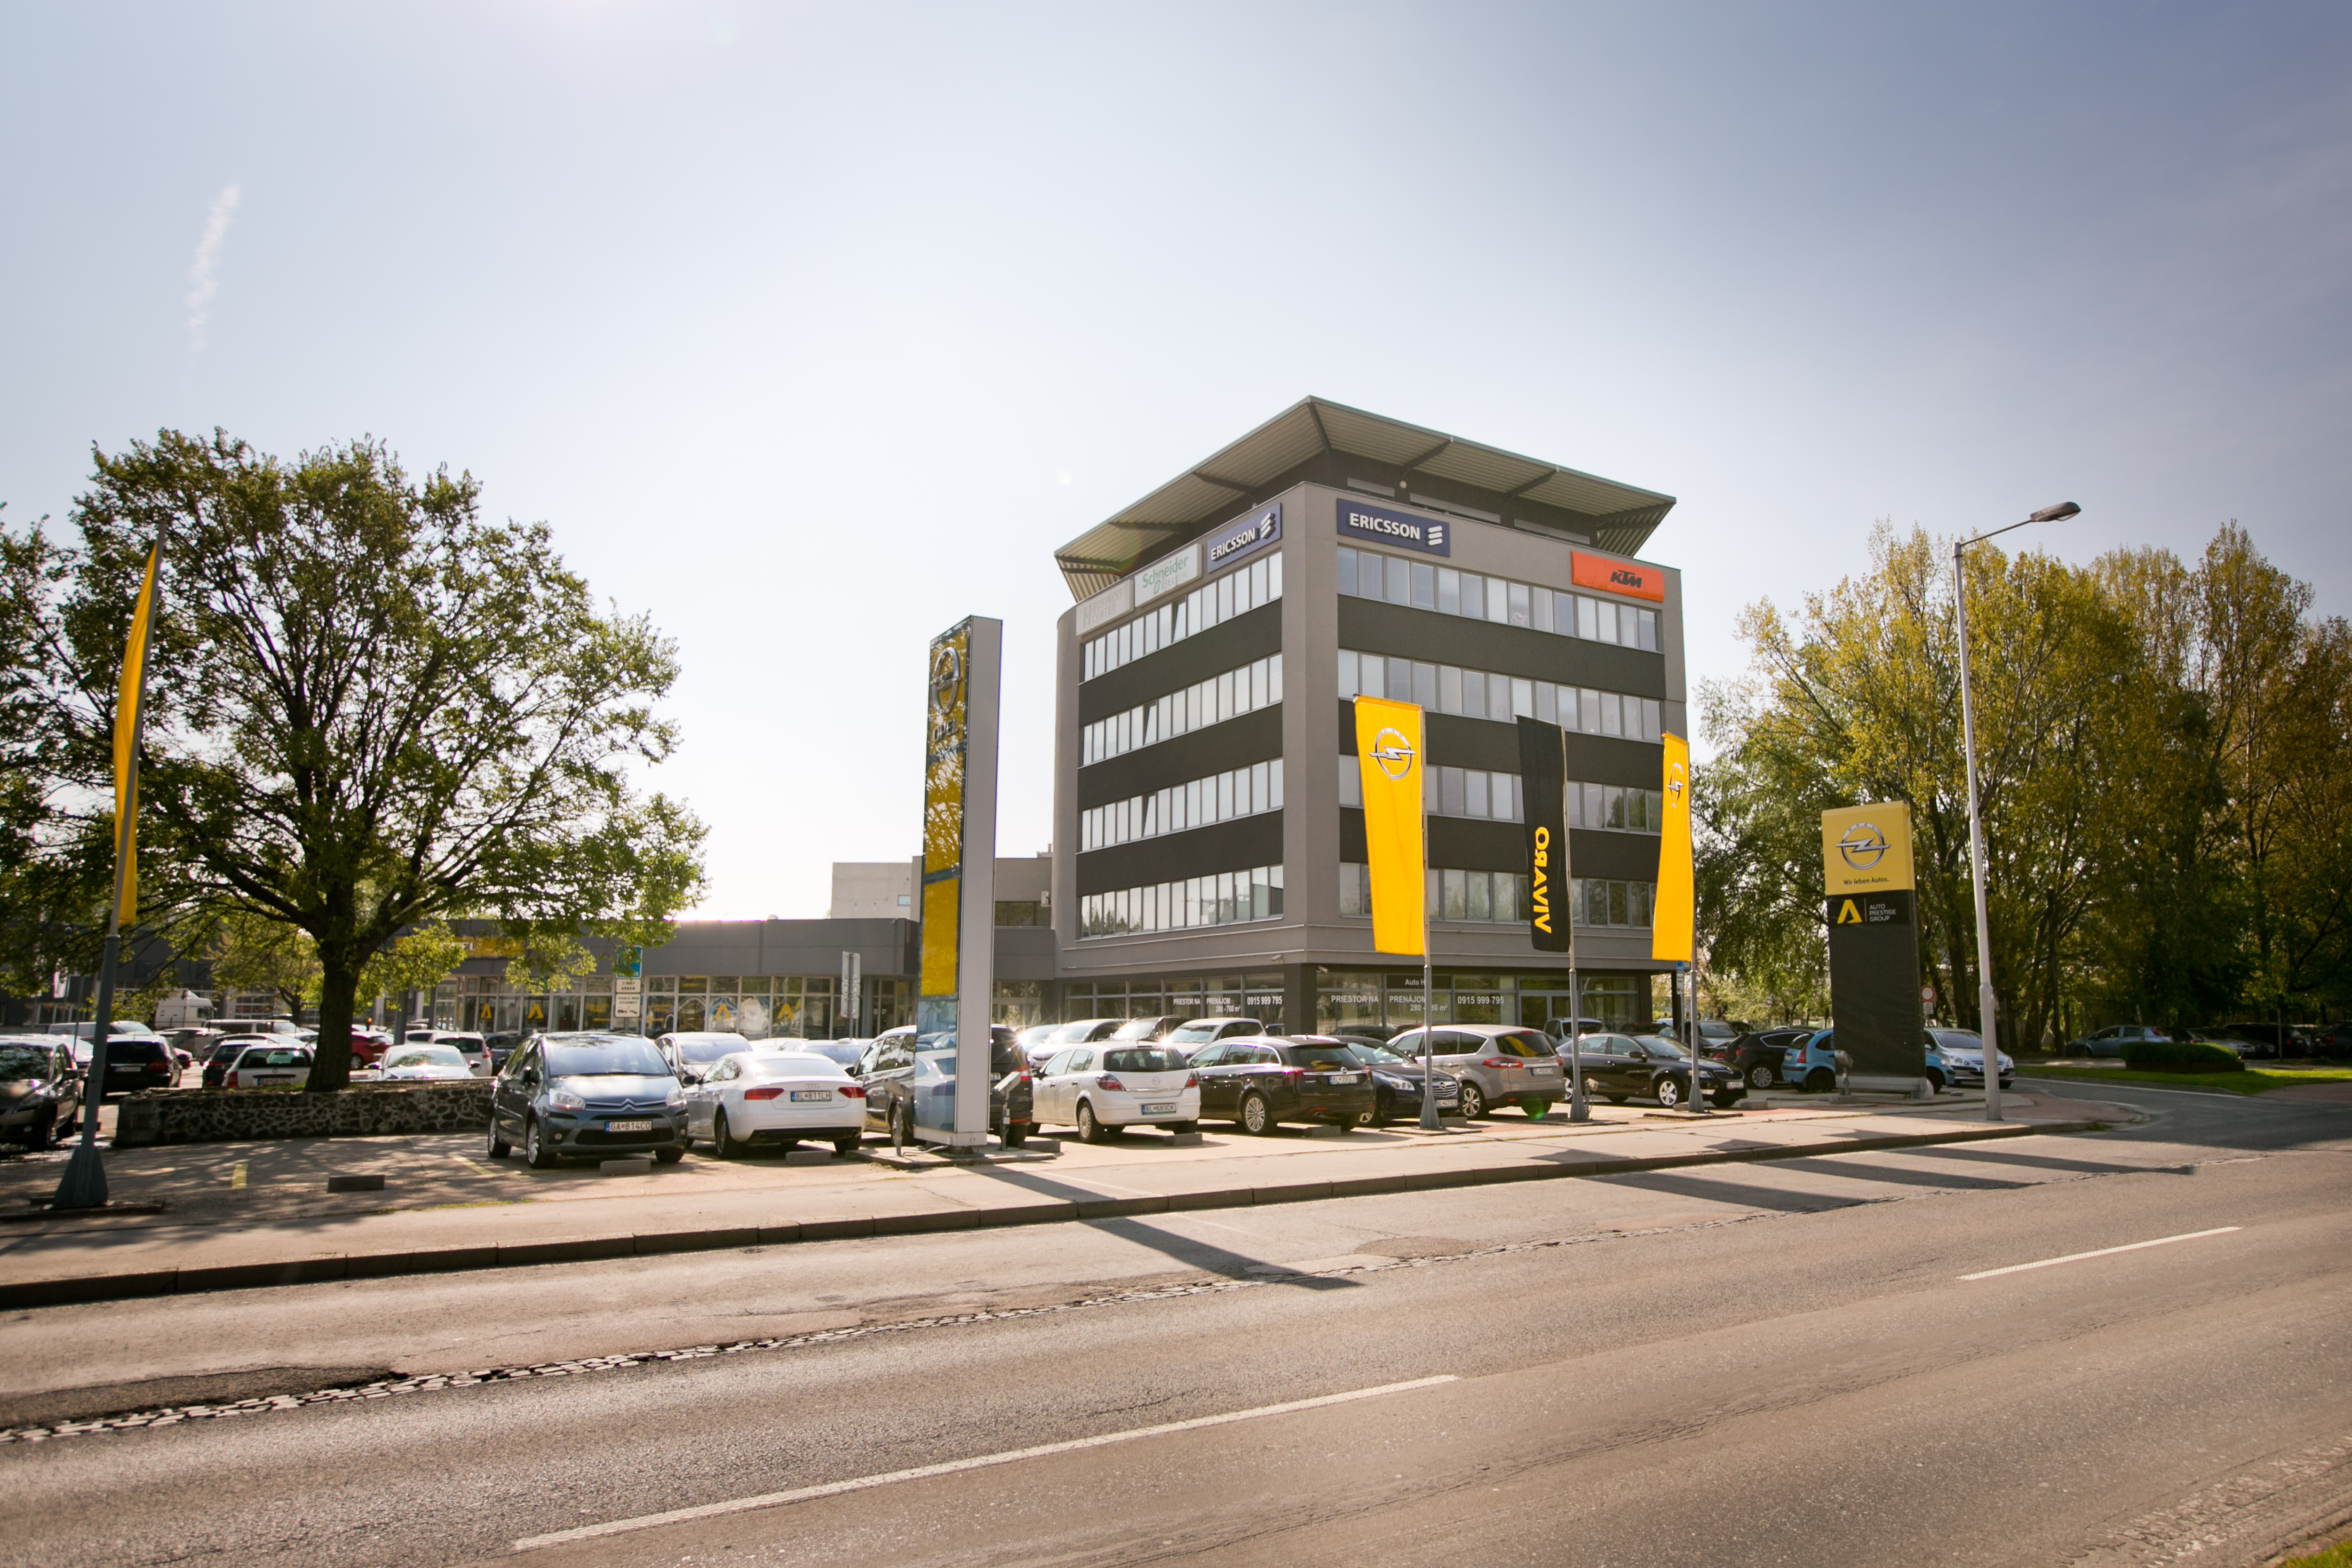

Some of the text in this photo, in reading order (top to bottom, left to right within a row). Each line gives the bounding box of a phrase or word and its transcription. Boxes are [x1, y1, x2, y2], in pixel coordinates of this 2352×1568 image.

[1350, 512, 1420, 540] ERICSSON
[1211, 527, 1255, 561] ERICSSON
[1143, 556, 1189, 588] Schneider
[1161, 570, 1188, 589] Electric
[1610, 569, 1642, 589] KTM
[1093, 588, 1123, 612] BUSINESS
[1092, 603, 1116, 623] CENTER
[932, 718, 958, 742] OPEL
[1848, 823, 1875, 832] OPEL
[1206, 996, 1231, 1005] PRENÁJOM
[1247, 995, 1282, 1005] 0915 999 795
[1457, 996, 1475, 1004] 0915
